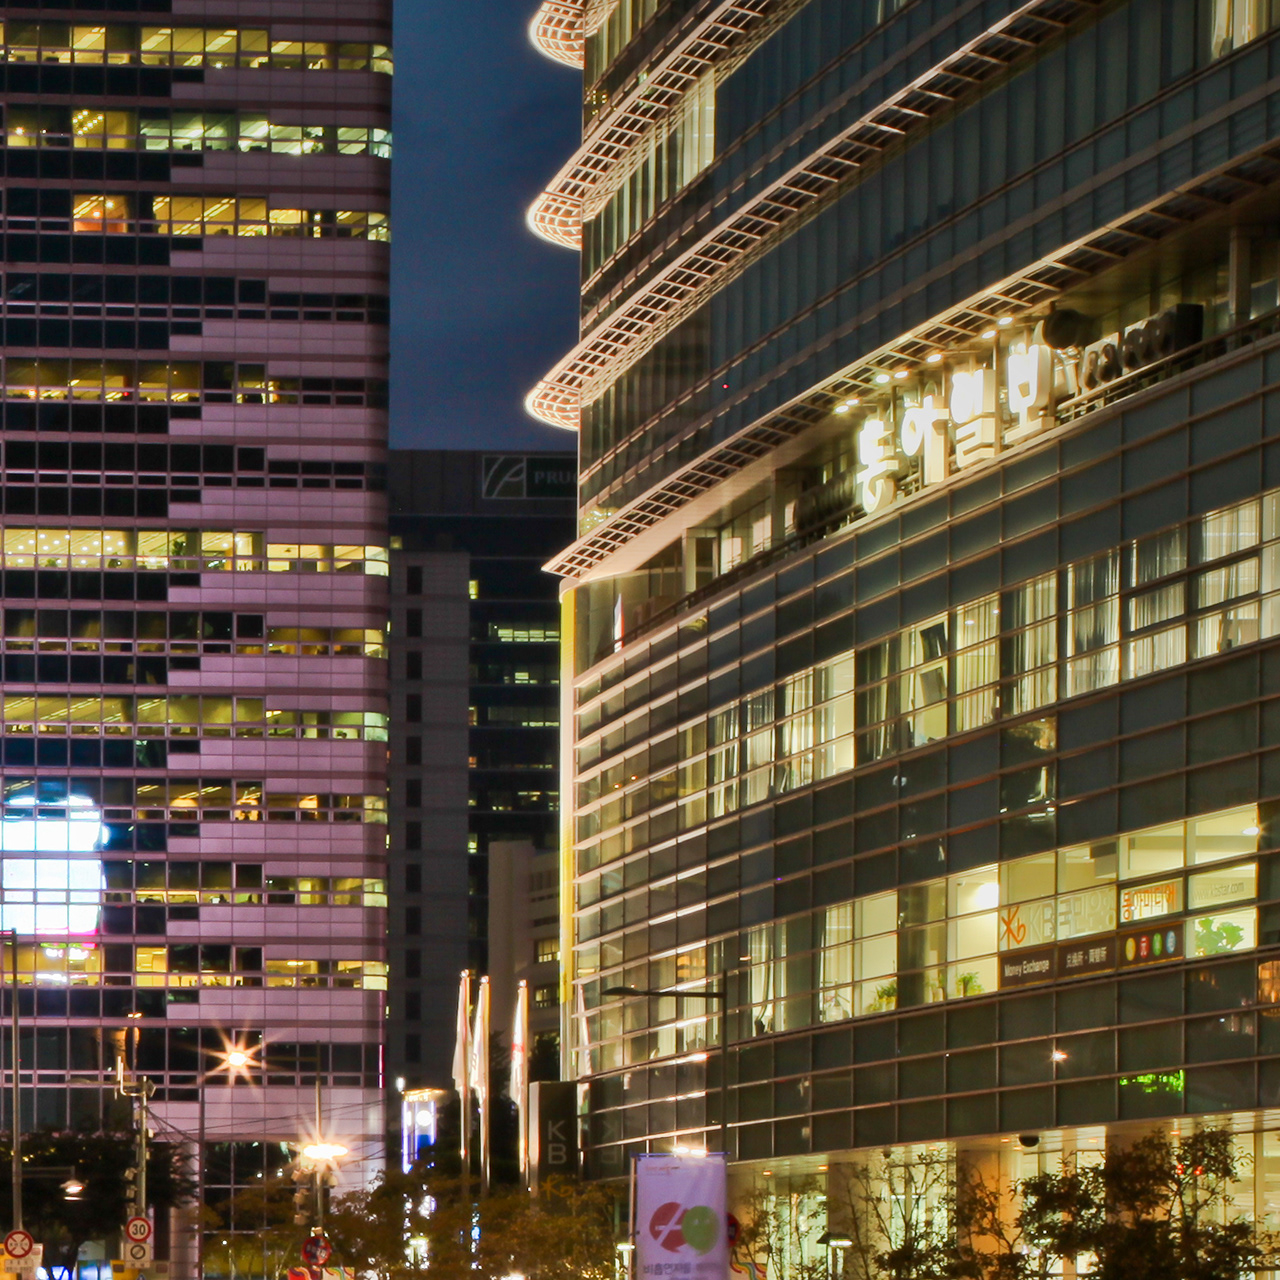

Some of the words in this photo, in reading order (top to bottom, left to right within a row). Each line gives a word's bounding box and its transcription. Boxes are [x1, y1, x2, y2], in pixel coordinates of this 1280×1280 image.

[1004, 964, 1022, 977] Money
[1023, 960, 1050, 974] Exchange
[132, 1224, 146, 1236] 30
